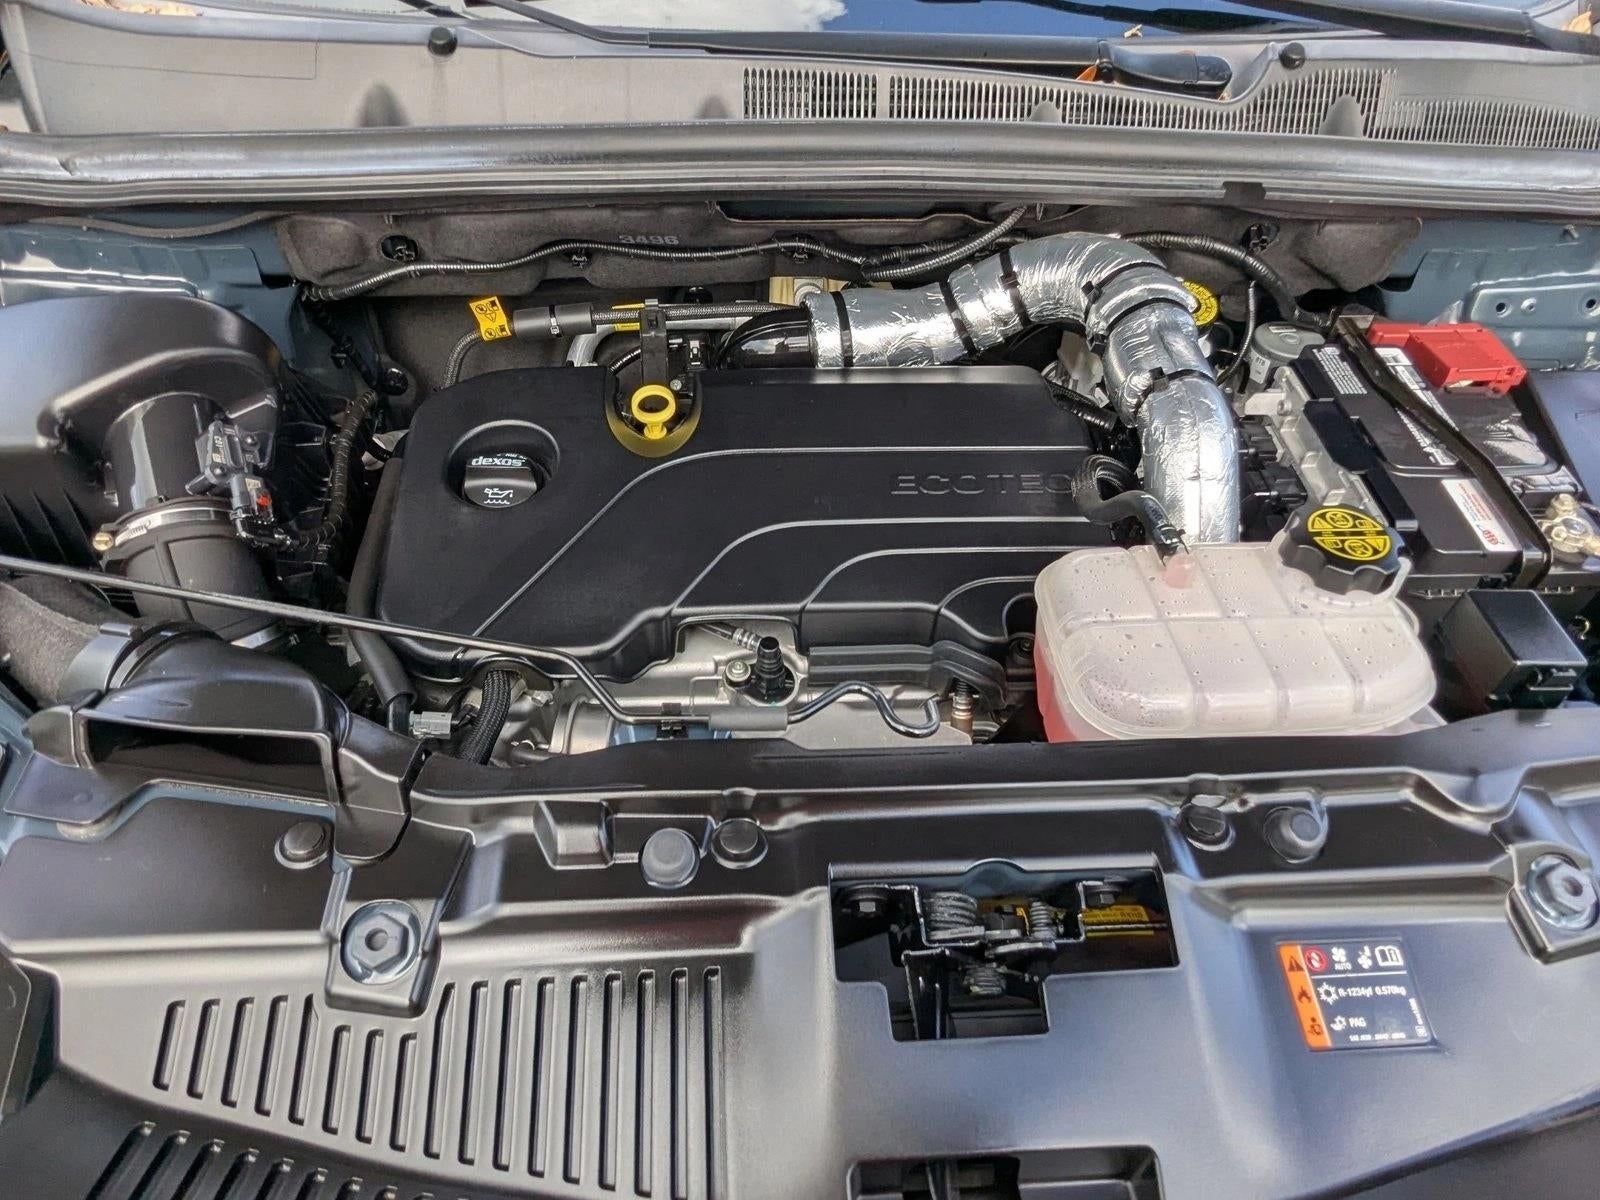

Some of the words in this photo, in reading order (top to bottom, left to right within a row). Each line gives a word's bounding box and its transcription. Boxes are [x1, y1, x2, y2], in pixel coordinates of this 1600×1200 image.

[471, 456, 522, 467] dexos
[890, 473, 1073, 495] ECOTEC
[1334, 962, 1352, 970] AUTO
[1348, 1016, 1367, 1028] PAG
